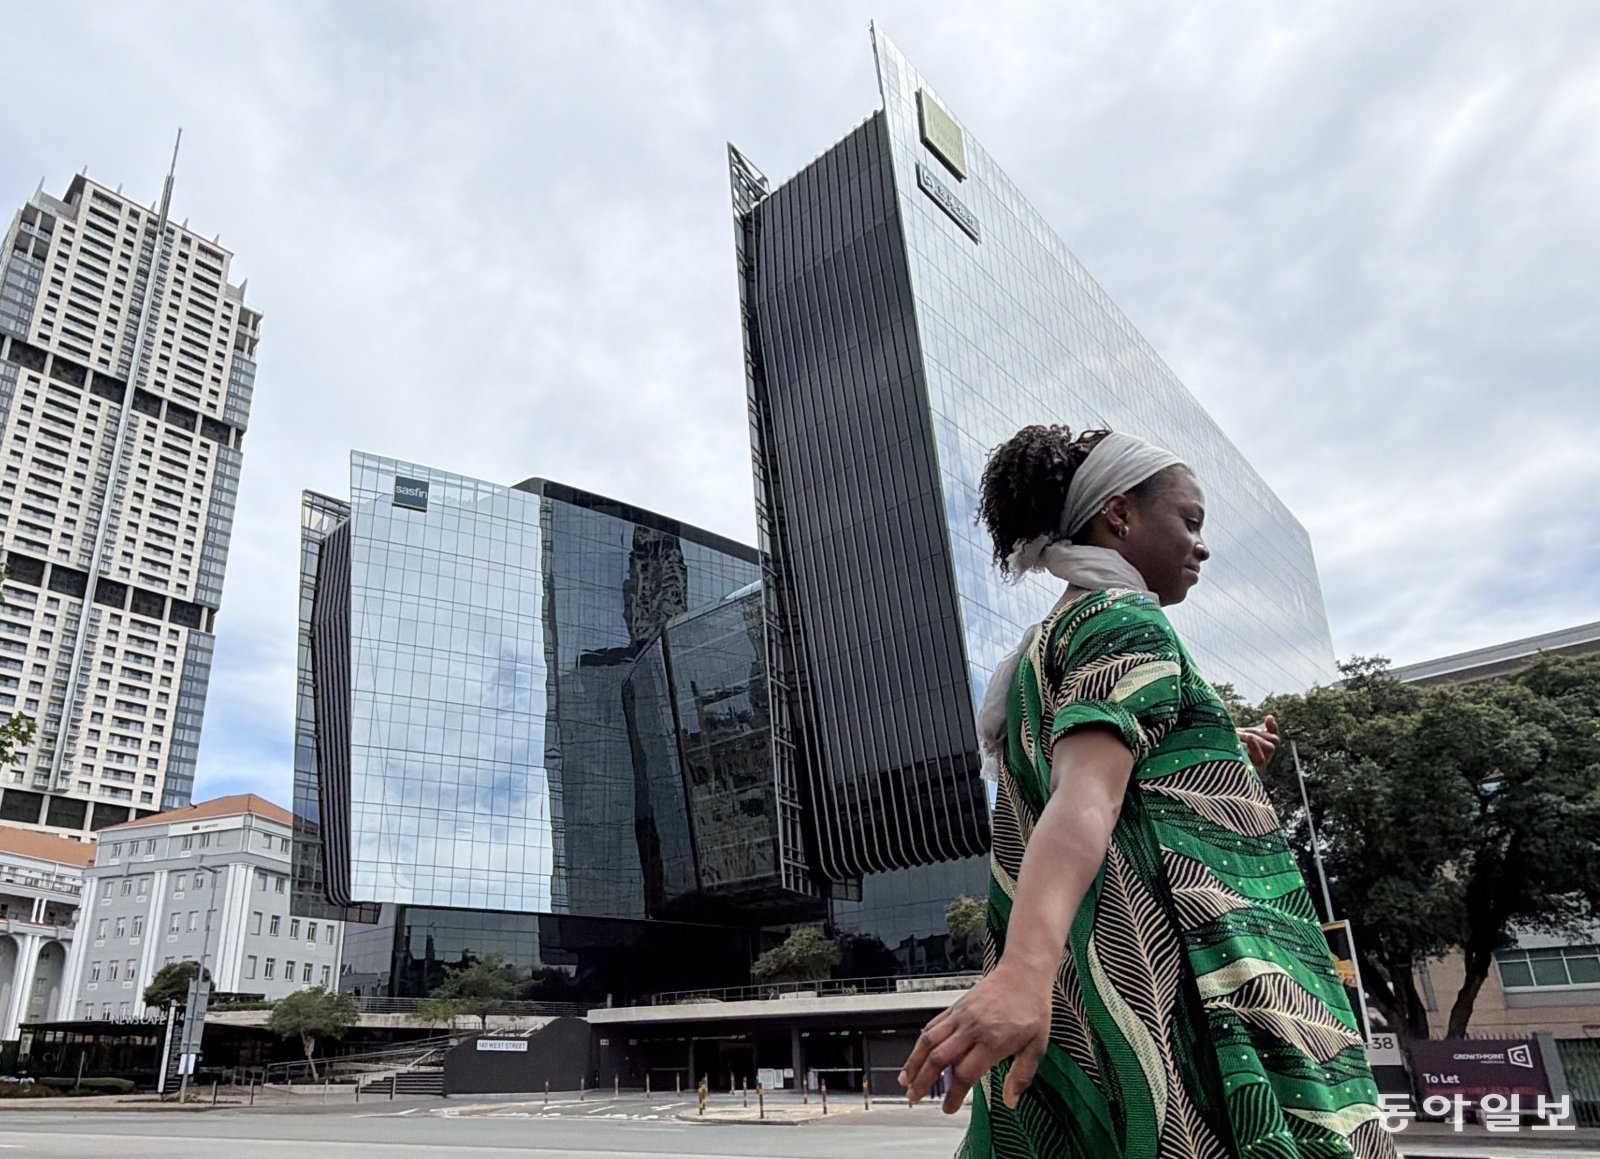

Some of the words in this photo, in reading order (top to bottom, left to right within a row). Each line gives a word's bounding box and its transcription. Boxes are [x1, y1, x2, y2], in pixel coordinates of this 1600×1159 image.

[395, 485, 428, 499] sasfin
[111, 1014, 140, 1025] NEWS
[504, 1042, 526, 1050] STREET
[1423, 1073, 1439, 1084] To
[1440, 1073, 1460, 1084] Let
